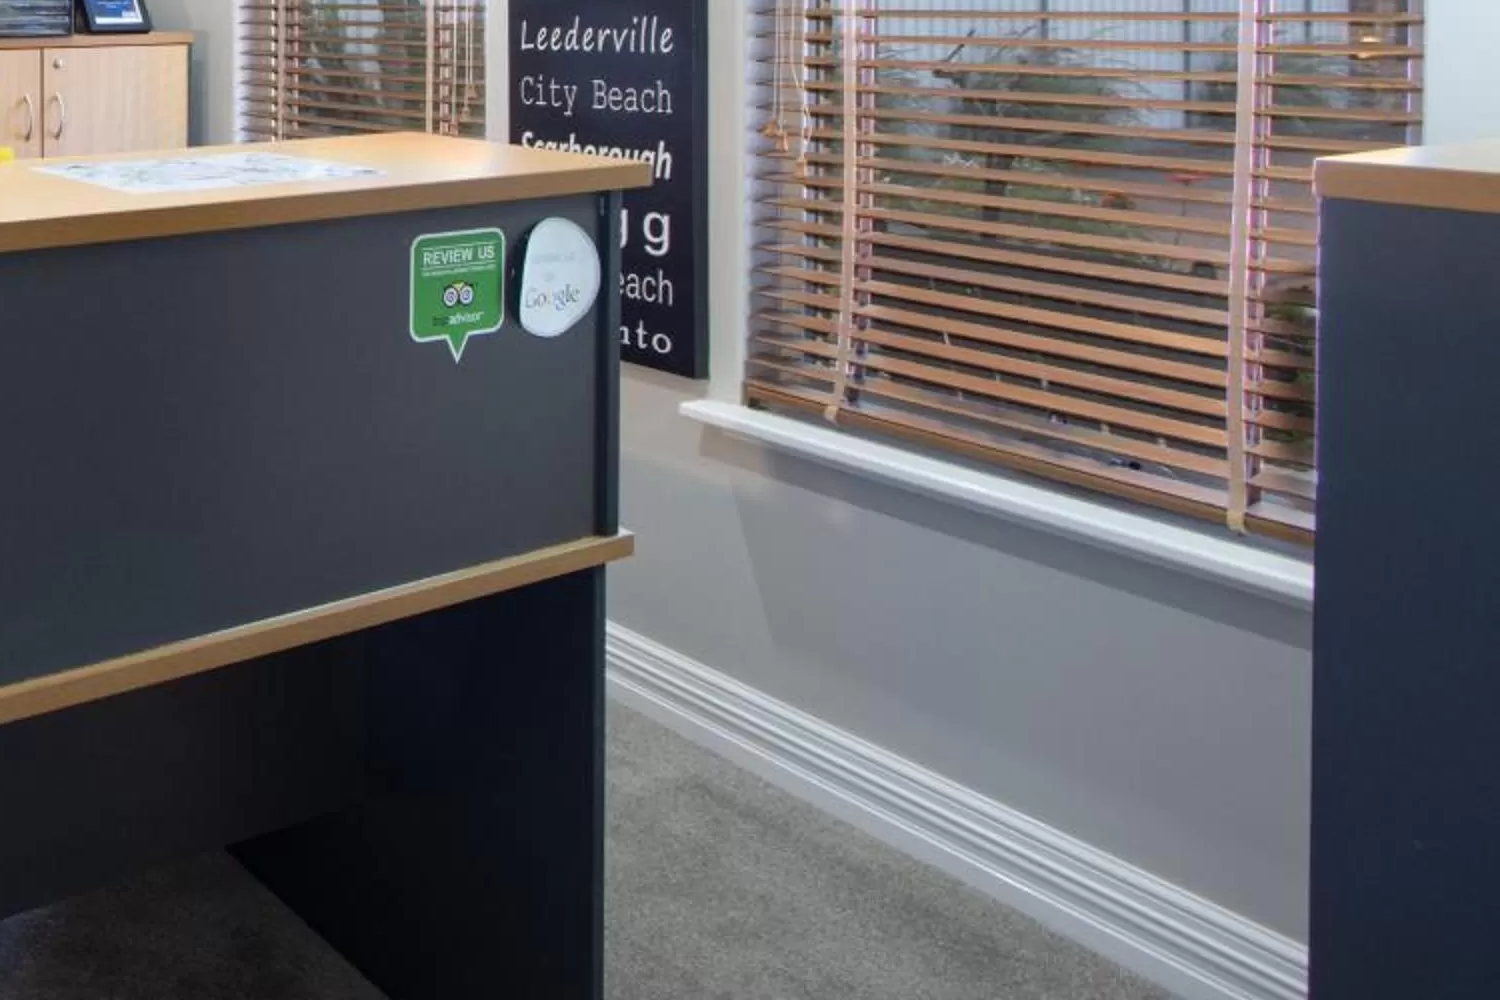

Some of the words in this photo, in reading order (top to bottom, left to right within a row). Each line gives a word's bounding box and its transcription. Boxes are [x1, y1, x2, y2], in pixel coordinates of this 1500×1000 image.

[520, 15, 674, 54] Leederville
[521, 74, 578, 117] City
[592, 79, 673, 114] Beach
[423, 248, 473, 265] REVIEW
[477, 245, 495, 259] US
[525, 283, 581, 312] Google
